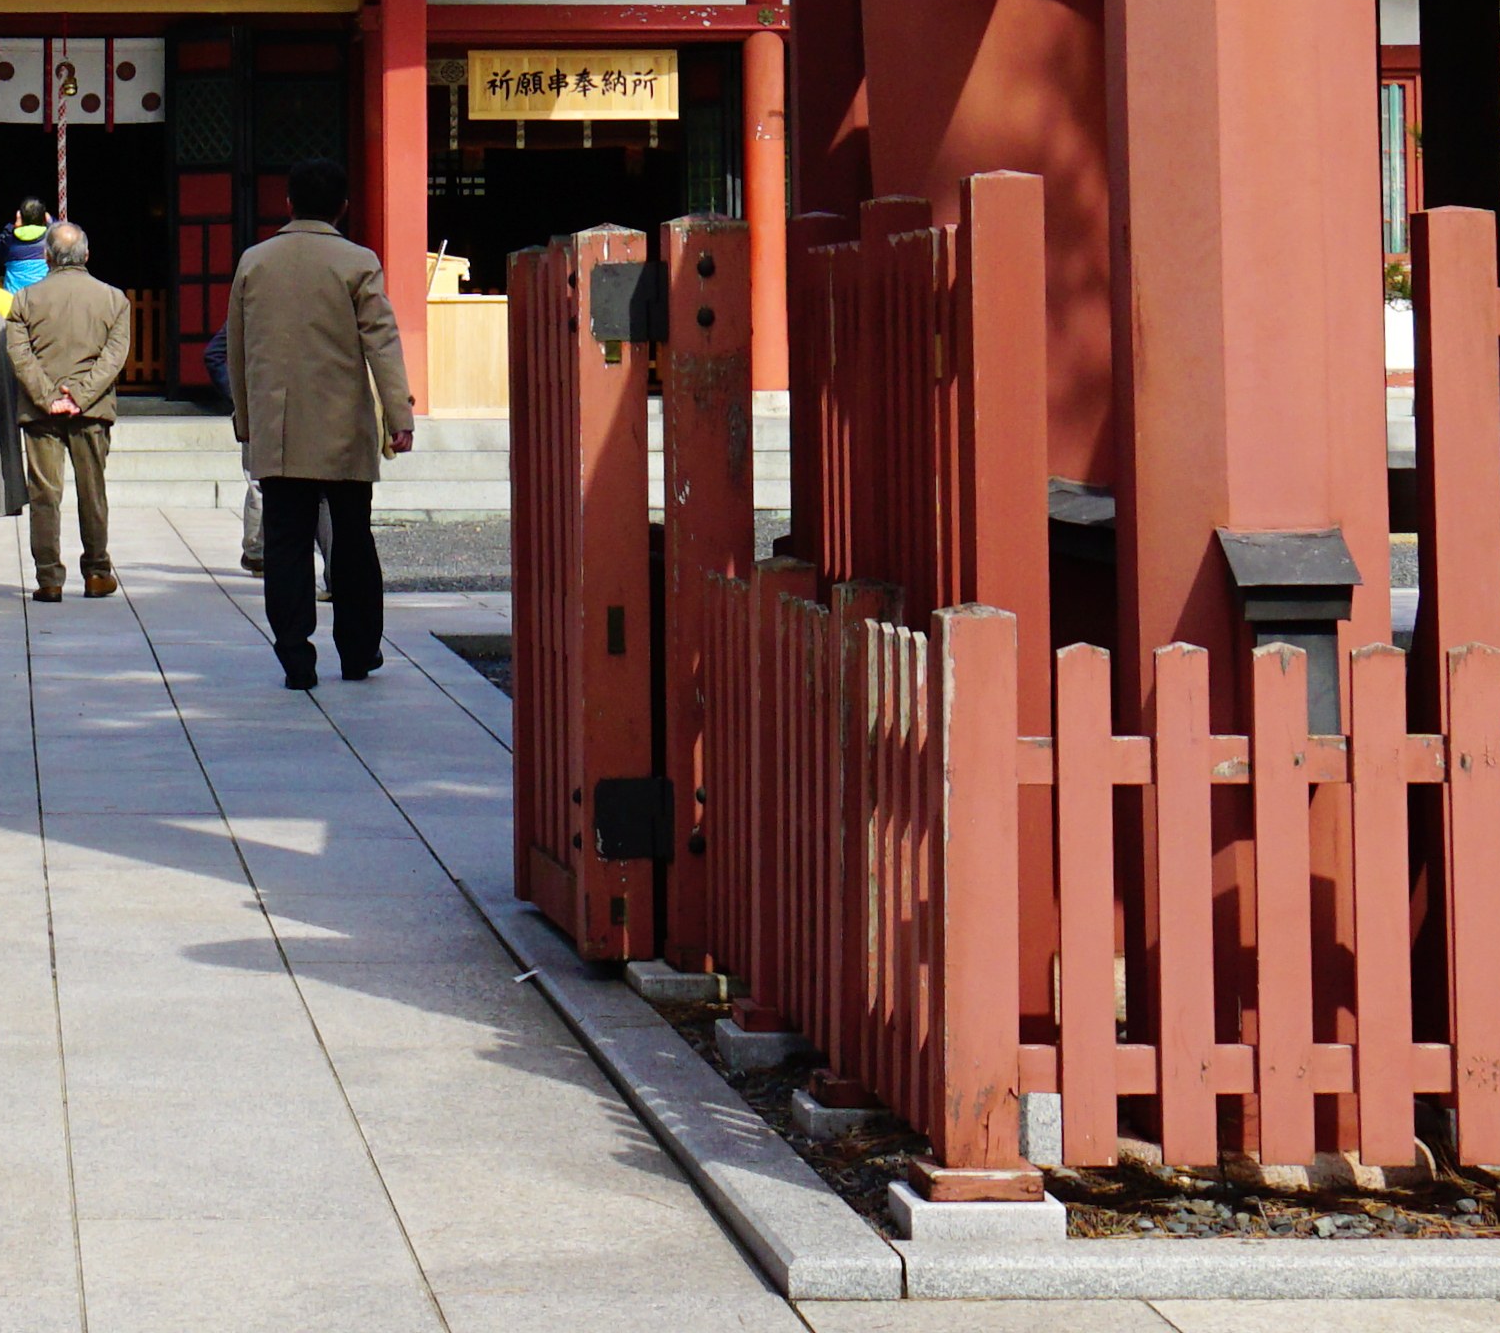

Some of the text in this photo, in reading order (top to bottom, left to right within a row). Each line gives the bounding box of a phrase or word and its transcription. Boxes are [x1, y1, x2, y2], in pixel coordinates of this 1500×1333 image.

[486, 67, 659, 101] 祈願串奉納所
